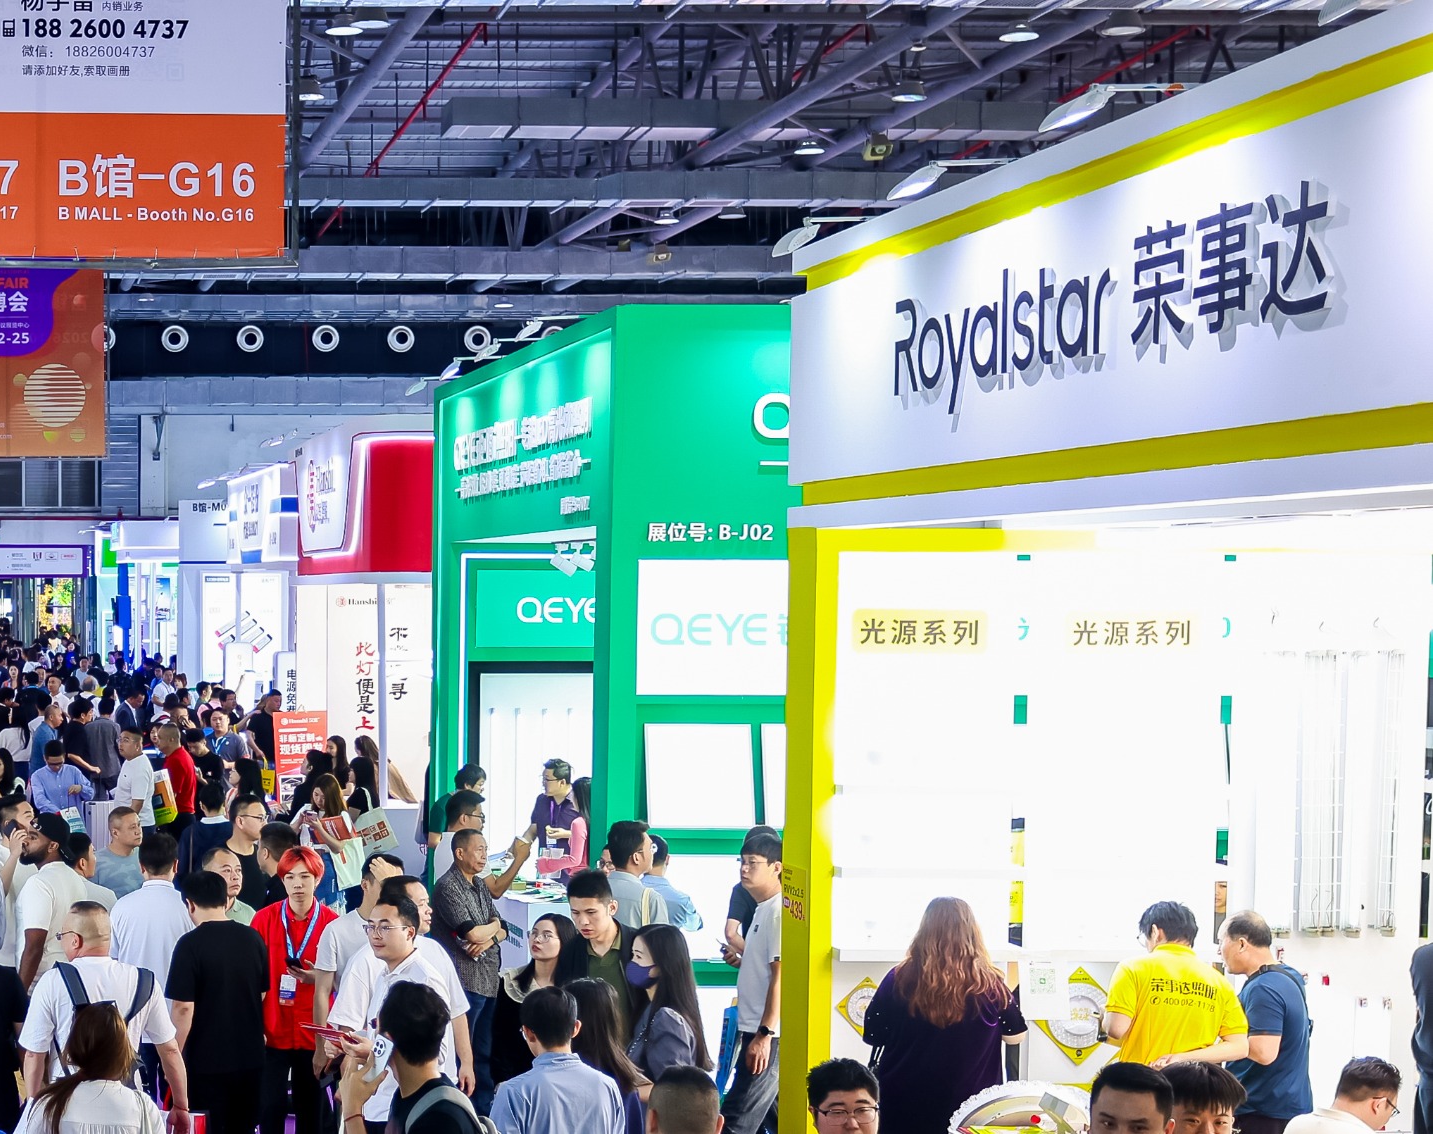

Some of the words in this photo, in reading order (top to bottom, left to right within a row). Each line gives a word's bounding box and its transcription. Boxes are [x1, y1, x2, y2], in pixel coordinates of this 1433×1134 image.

[101, 1, 143, 12] 内销业务
[22, 18, 62, 38] 188
[69, 18, 125, 38] 2600
[133, 19, 189, 39] 4737
[65, 46, 155, 58] 18826004737
[58, 207, 70, 221] B
[74, 207, 123, 221] MALL
[136, 207, 188, 223] Booth
[192, 208, 255, 223] No.G16
[893, 267, 1115, 416] Royalstar
[1130, 180, 1330, 345] 荣事达
[718, 523, 774, 541] B-J02
[348, 597, 378, 605] Hanshi
[859, 617, 980, 647] 光源系列
[1073, 620, 1192, 646] 光源系列
[1150, 977, 1218, 1001] 荣事达照明
